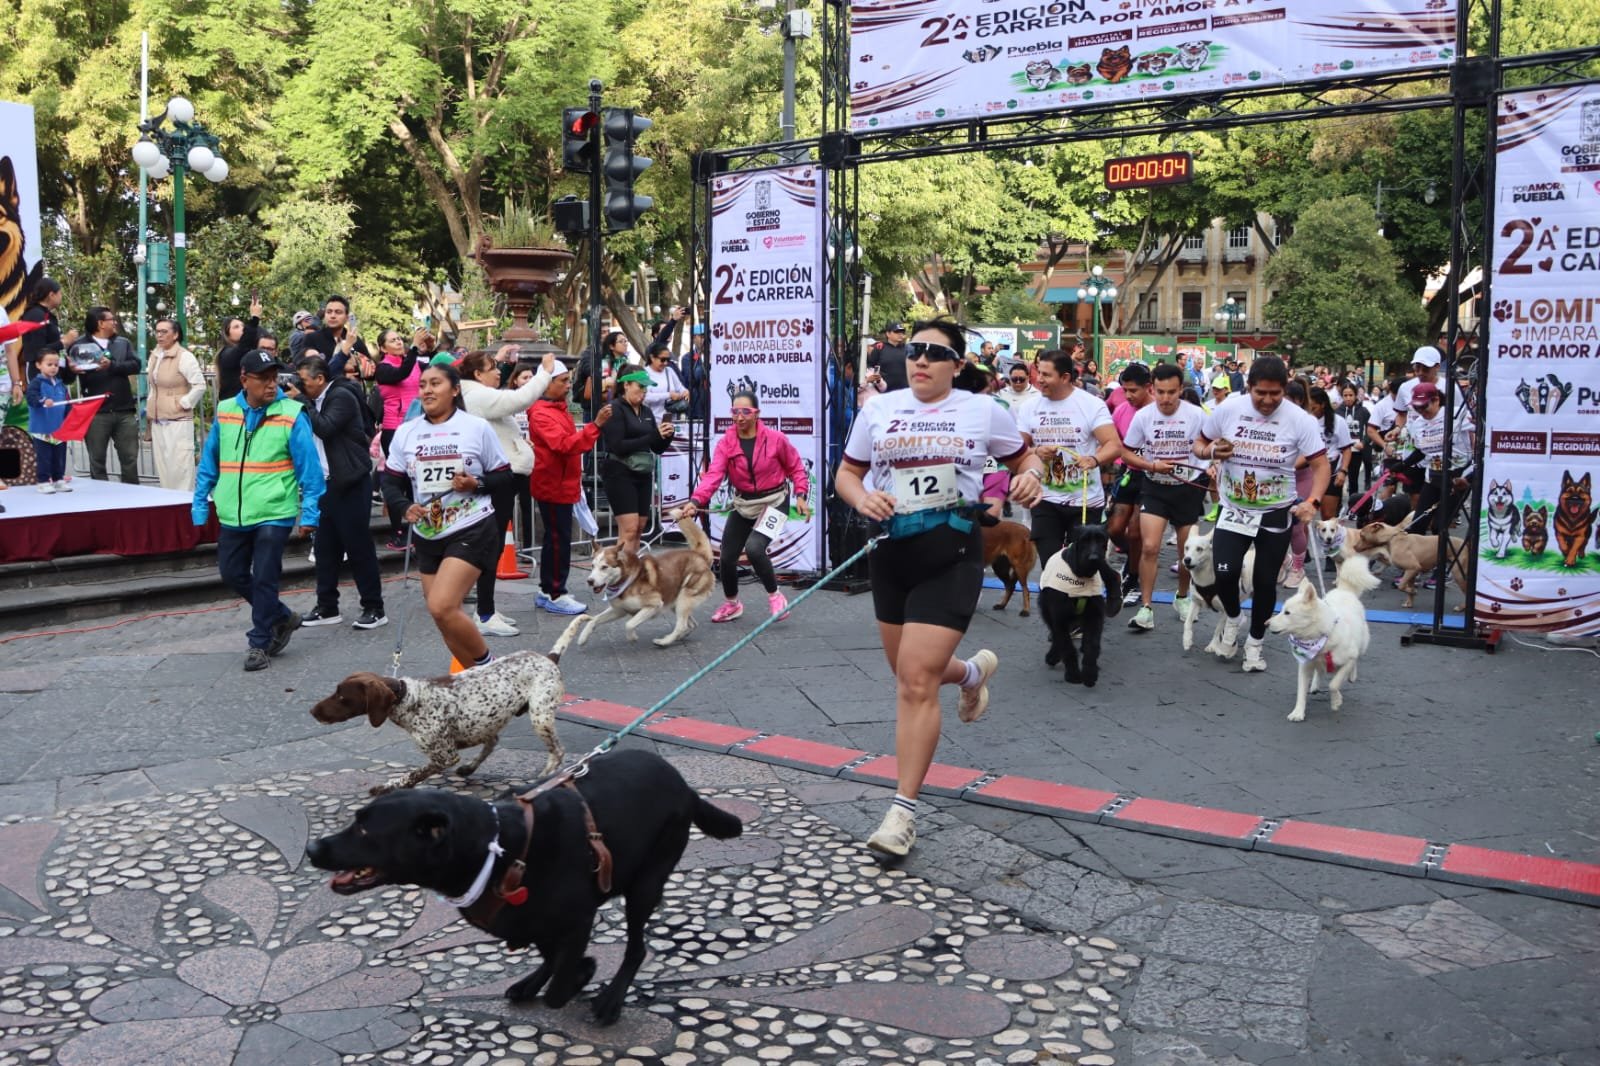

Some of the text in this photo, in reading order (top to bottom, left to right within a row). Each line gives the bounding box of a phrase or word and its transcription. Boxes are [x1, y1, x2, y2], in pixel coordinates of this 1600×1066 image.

[1100, 10, 1143, 25] POR
[1149, 1, 1217, 18] AMOR
[975, 11, 1096, 38] CARRERA
[1139, 22, 1205, 38] REGIDURÍAS
[1074, 34, 1128, 47] IMPARABLE
[1007, 41, 1063, 55] Puebla
[1575, 153, 1600, 165] EST
[1109, 158, 1186, 183] 00:00:04
[1527, 182, 1560, 192] AMOR
[1513, 190, 1565, 204] PUEBLA
[745, 209, 781, 221] GOBIERNO
[753, 217, 781, 227] ESTADO
[721, 244, 750, 254] PUEBLA
[1561, 252, 1600, 272] CA
[750, 264, 812, 287] EDICIÓN
[747, 285, 814, 302] CARRERA
[724, 318, 801, 340] LOMITOS
[731, 339, 795, 353] IMPARABLES
[1498, 343, 1590, 359] POR AMOR
[716, 352, 813, 365] POR AMOR A PUEBLA
[760, 383, 800, 399] Puebla
[911, 420, 956, 428] EDICIÓN
[1250, 430, 1276, 438] EDICIÓN
[430, 443, 458, 451] EDICIÓN
[877, 435, 965, 452] LOMITOS
[1232, 440, 1280, 453] OMITOS
[1496, 441, 1542, 451] IMPARABLE
[423, 466, 455, 482] 275
[909, 475, 940, 496] 12
